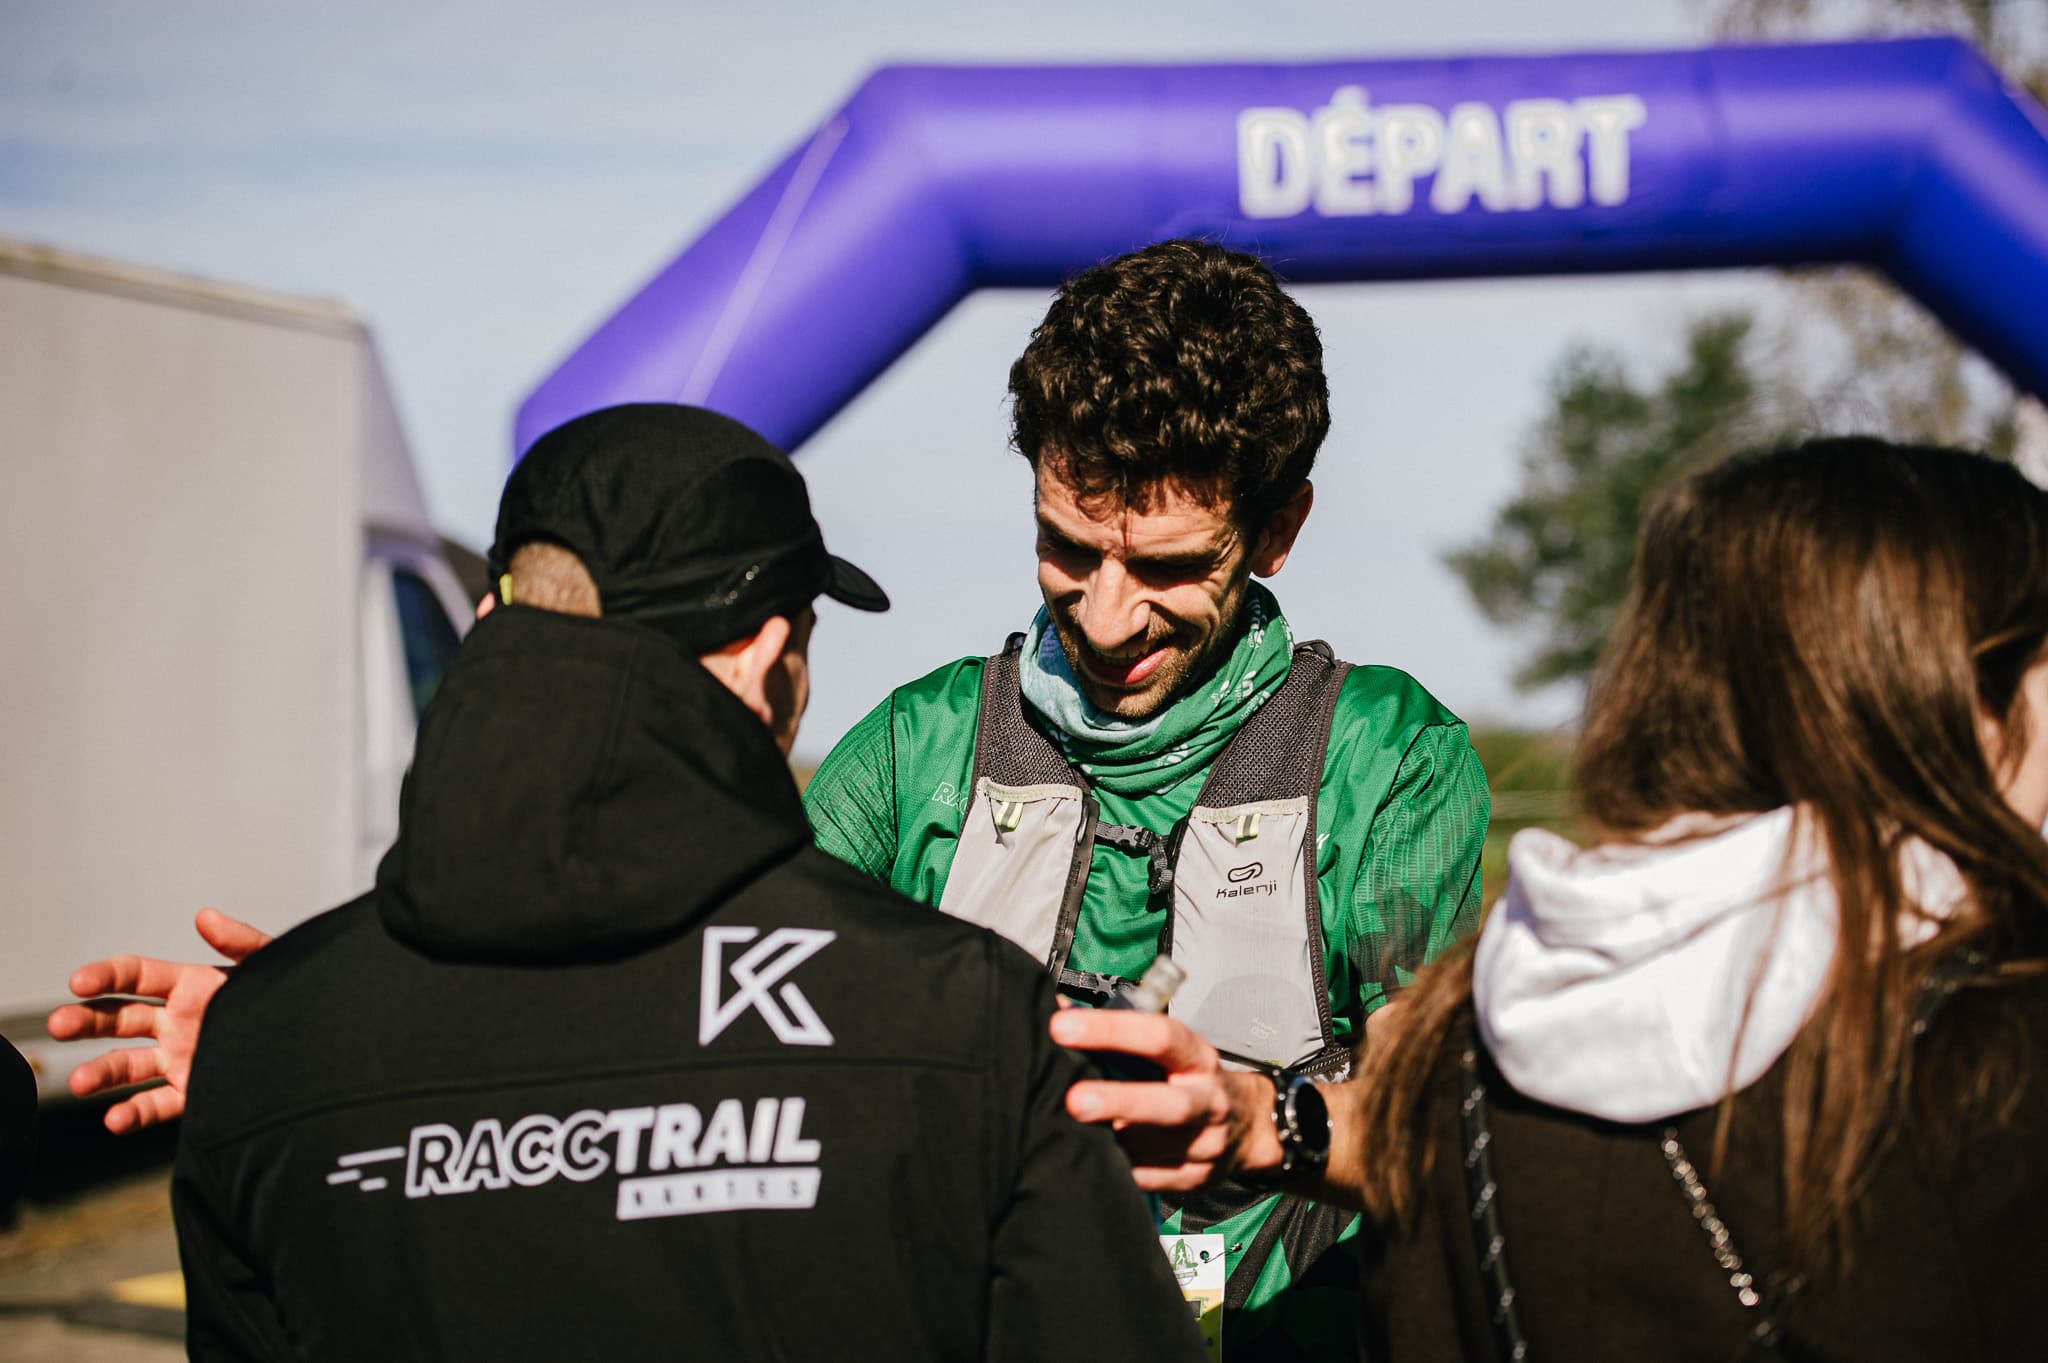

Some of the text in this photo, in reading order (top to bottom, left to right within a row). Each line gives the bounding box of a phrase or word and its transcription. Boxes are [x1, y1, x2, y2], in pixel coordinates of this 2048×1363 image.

[1236, 85, 1648, 219] DÉPART
[1216, 880, 1277, 899] Kalenji
[699, 926, 837, 1046] K
[404, 1097, 822, 1198] RACCTRAIL
